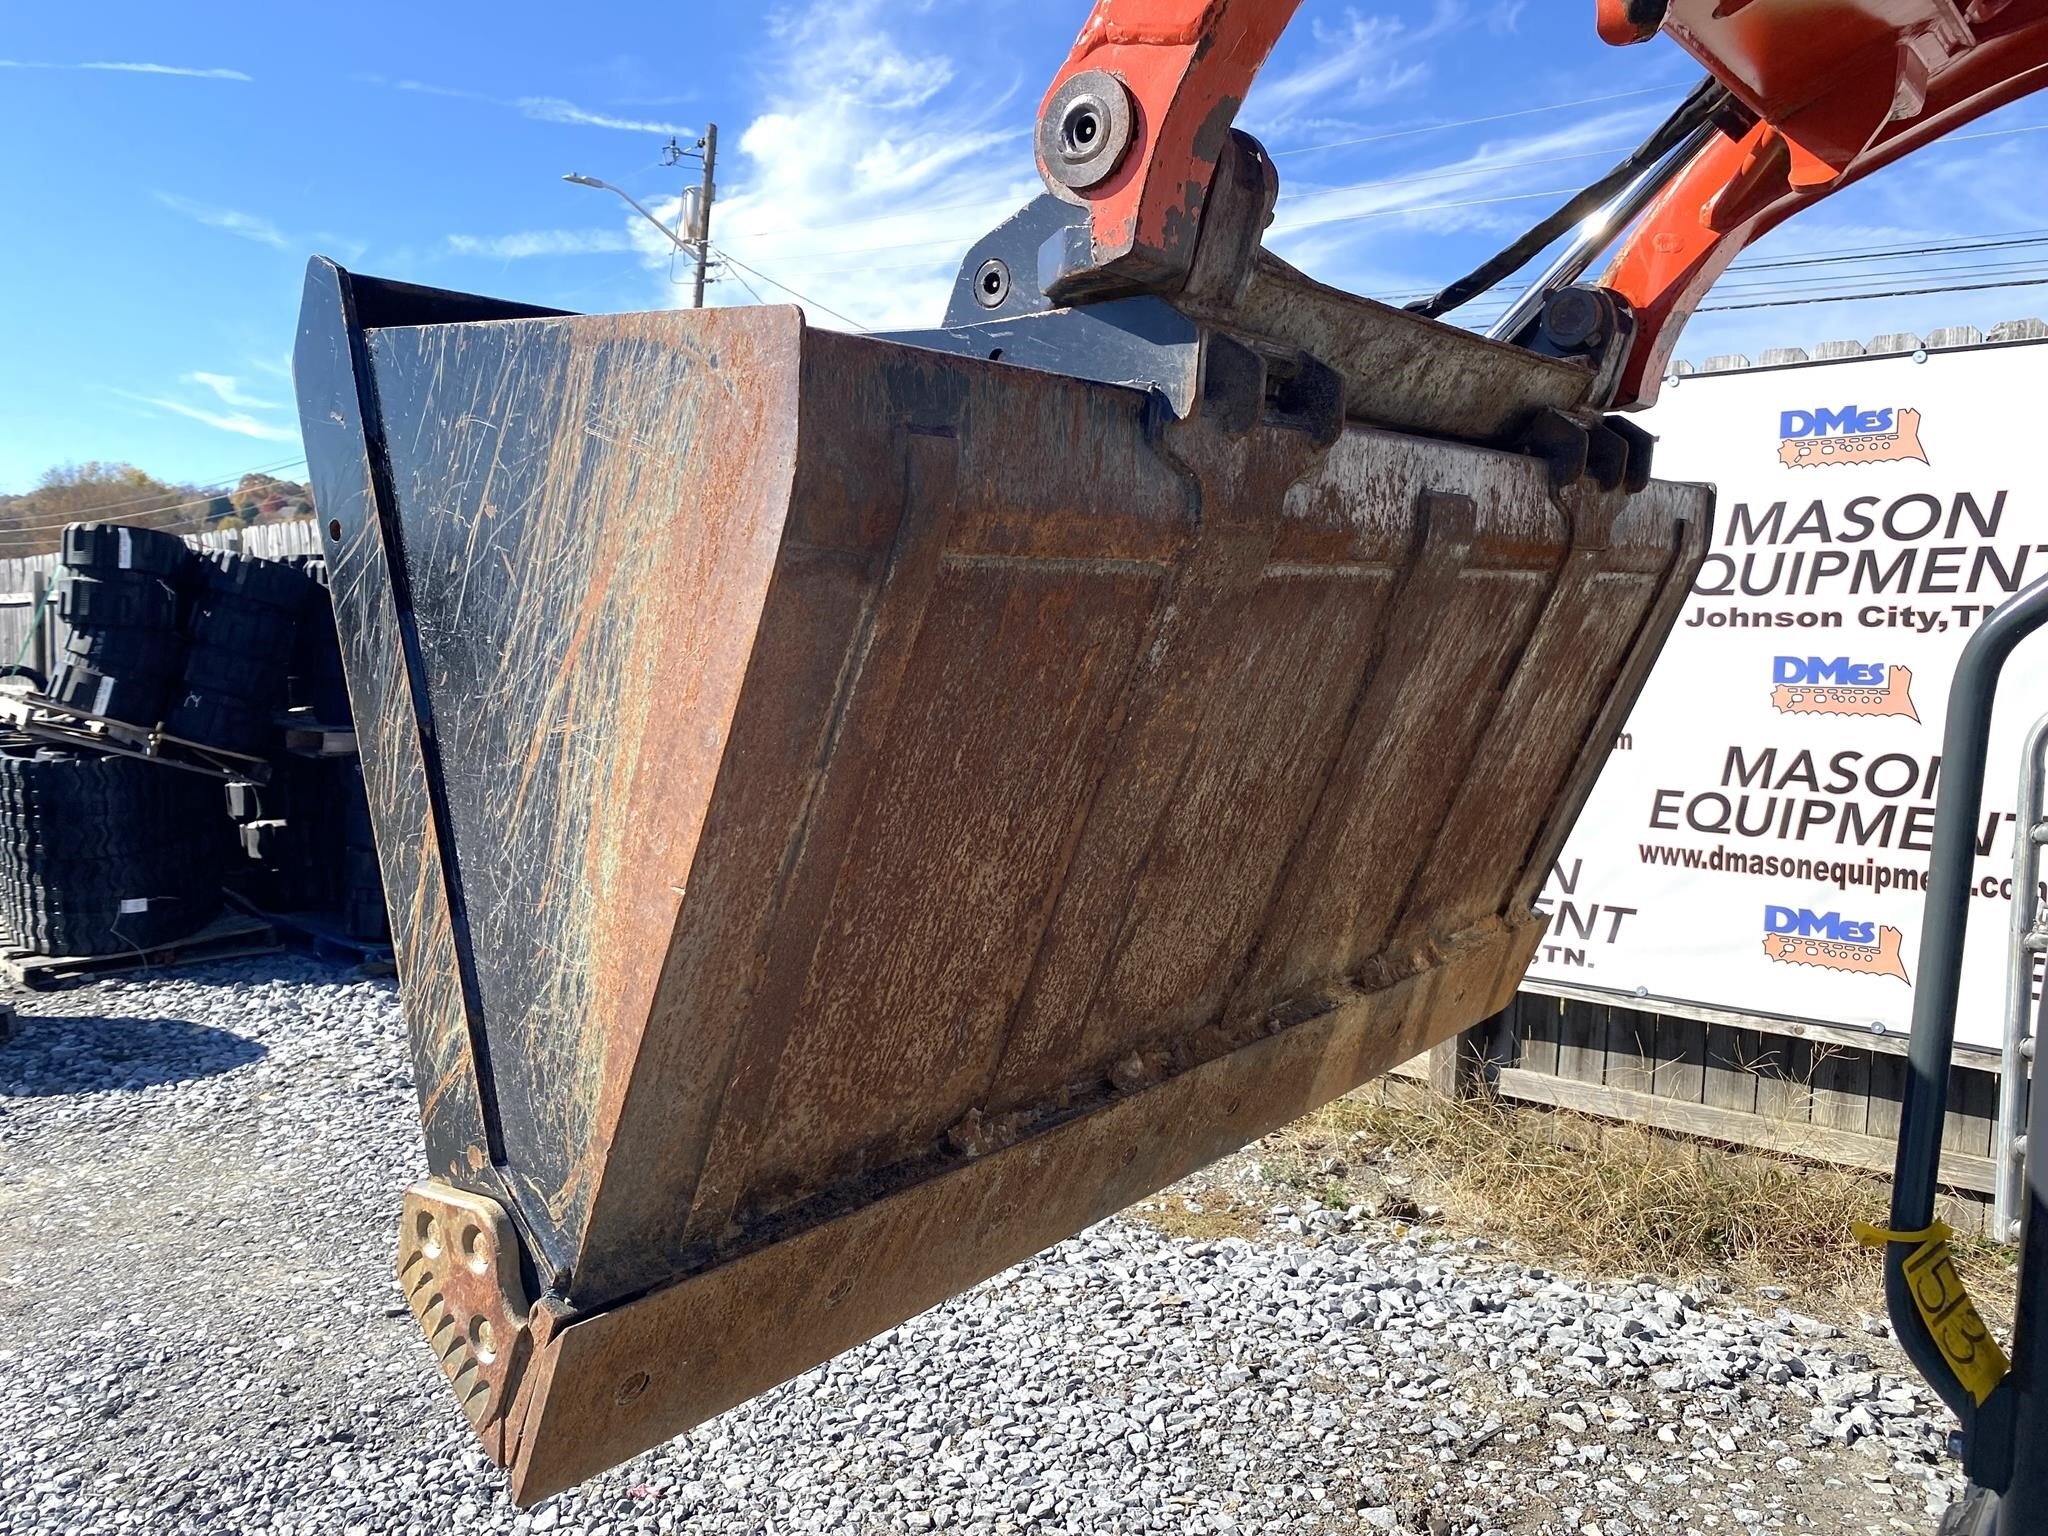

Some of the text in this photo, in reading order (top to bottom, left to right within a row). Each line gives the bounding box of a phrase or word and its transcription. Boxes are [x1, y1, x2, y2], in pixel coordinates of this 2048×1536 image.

[1724, 490, 2008, 546] MASON
[1691, 545, 2048, 596] QUIPMEN
[1685, 607, 1842, 628] Johnson
